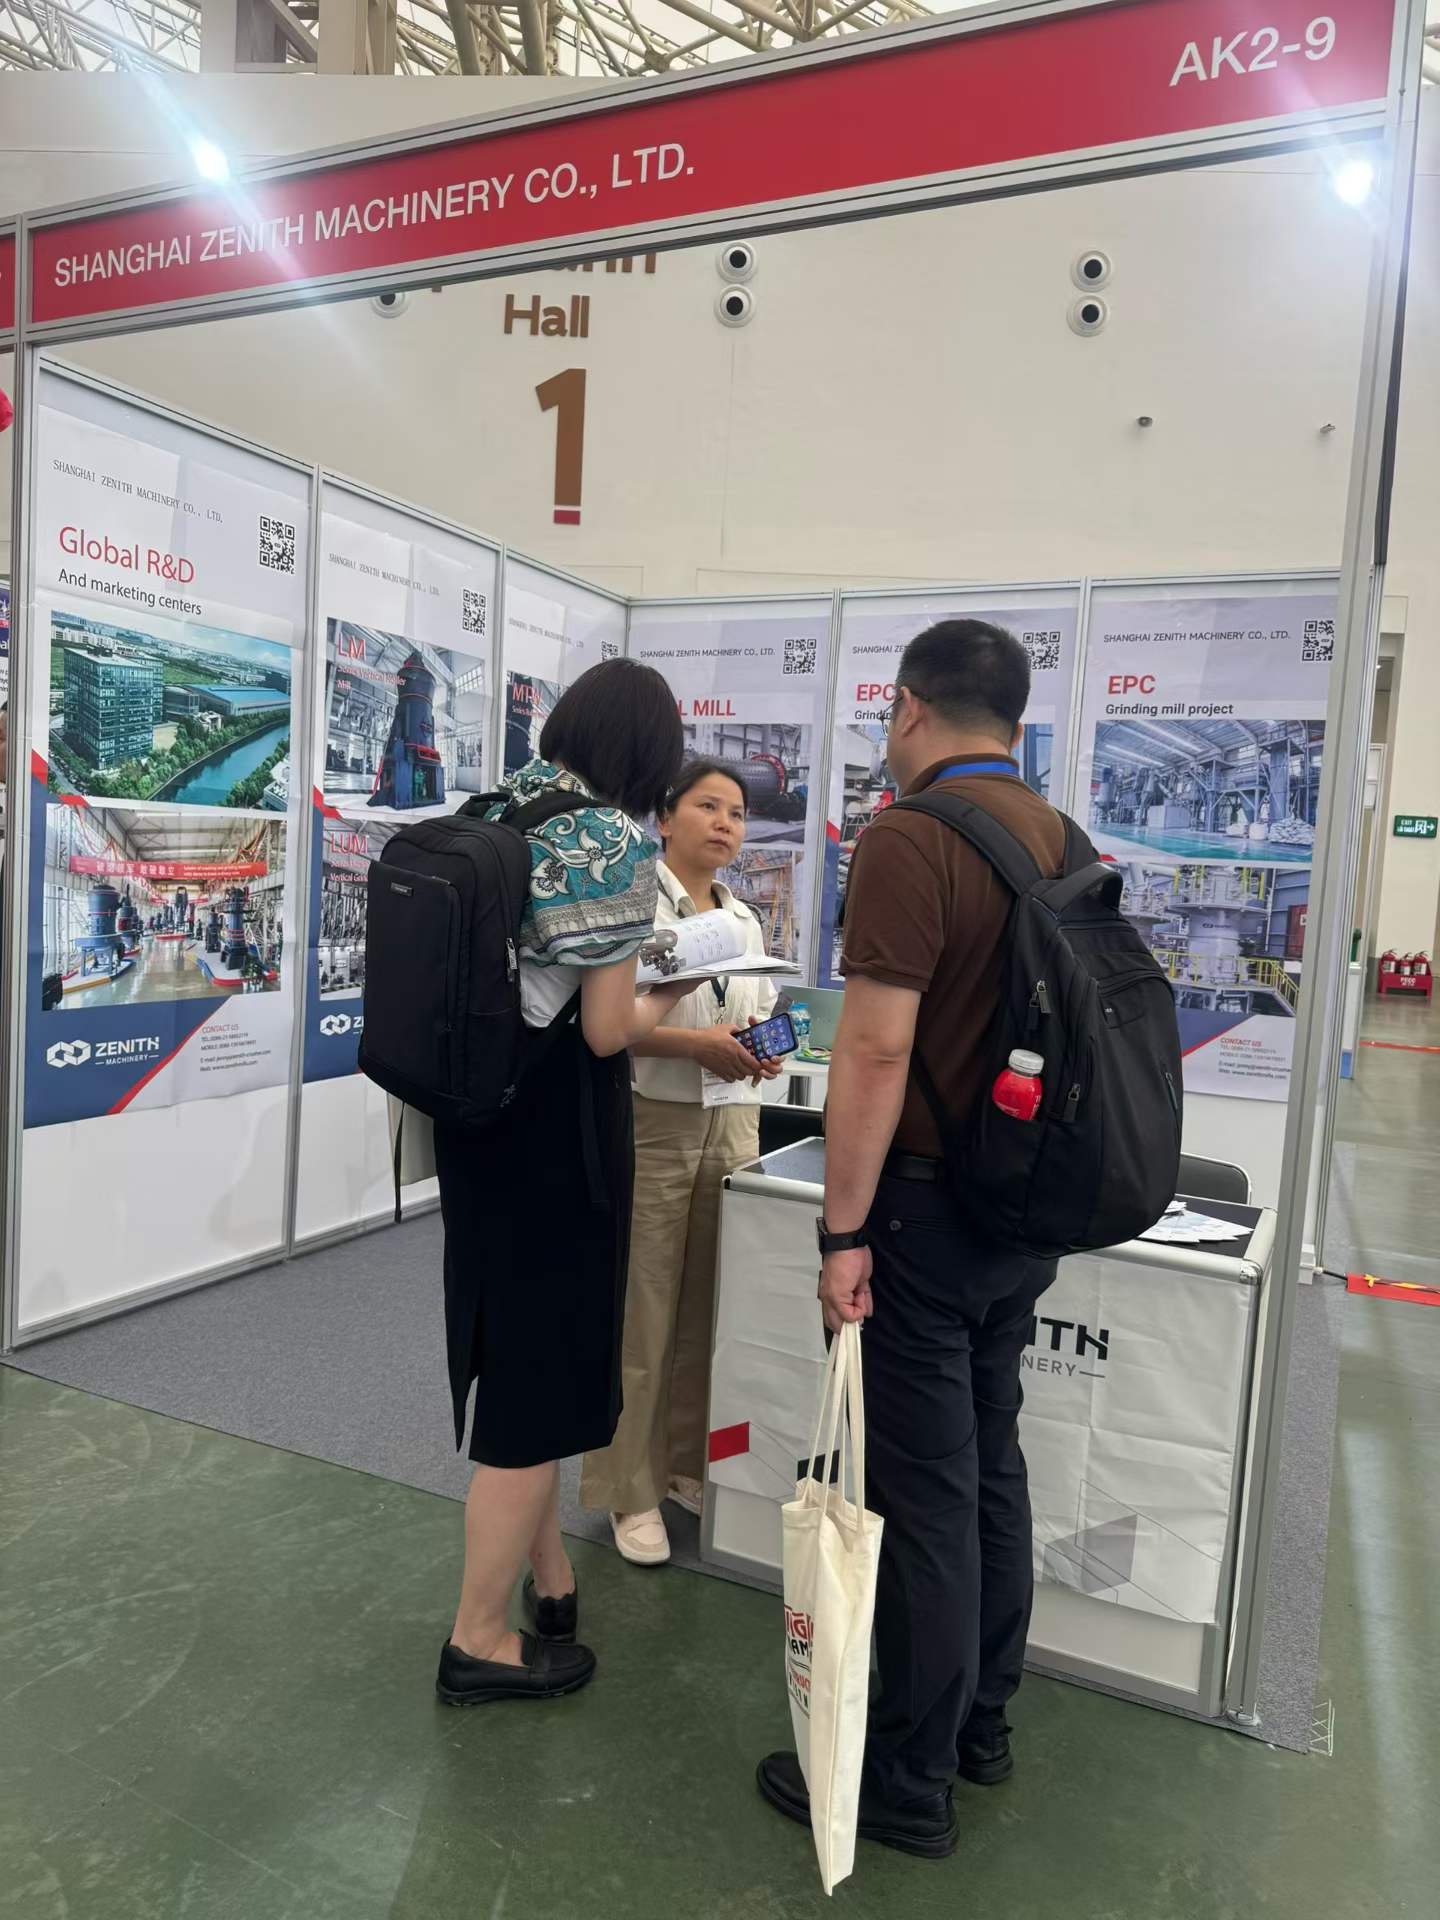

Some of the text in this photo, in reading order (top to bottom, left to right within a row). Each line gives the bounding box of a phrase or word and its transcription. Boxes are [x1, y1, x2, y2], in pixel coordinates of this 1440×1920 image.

[1168, 16, 1337, 88] AK2-9
[54, 142, 695, 287] SHANGHAI ZENITH MACHINERY CO., LTD.
[504, 294, 590, 338] Hall
[535, 368, 587, 506] 1
[53, 459, 96, 482] SHANGHAI
[101, 475, 133, 494] ZENITH
[136, 487, 181, 509] MACHINERY
[206, 509, 224, 524] LTD.
[59, 526, 195, 583] Global R&D
[58, 568, 202, 615] And marketing centers
[337, 632, 367, 660] LM
[1103, 633, 1151, 643] SHANGHAI
[1153, 632, 1186, 642] ZENITH
[1189, 631, 1244, 641] MACHINERY
[1270, 630, 1291, 639] LTD.
[640, 650, 675, 659] SHANGHAI
[676, 649, 700, 658] ZENITH
[702, 648, 743, 657] MACHINERY
[852, 645, 892, 654] SHANGHAI
[856, 683, 897, 701] EPC
[1107, 674, 1156, 695] EPC
[693, 699, 736, 716] MILL
[1105, 703, 1234, 717] Grinding mill project
[331, 831, 368, 854] LUM
[95, 1036, 160, 1057] ZENITH
[105, 1054, 149, 1066] MACHINERY
